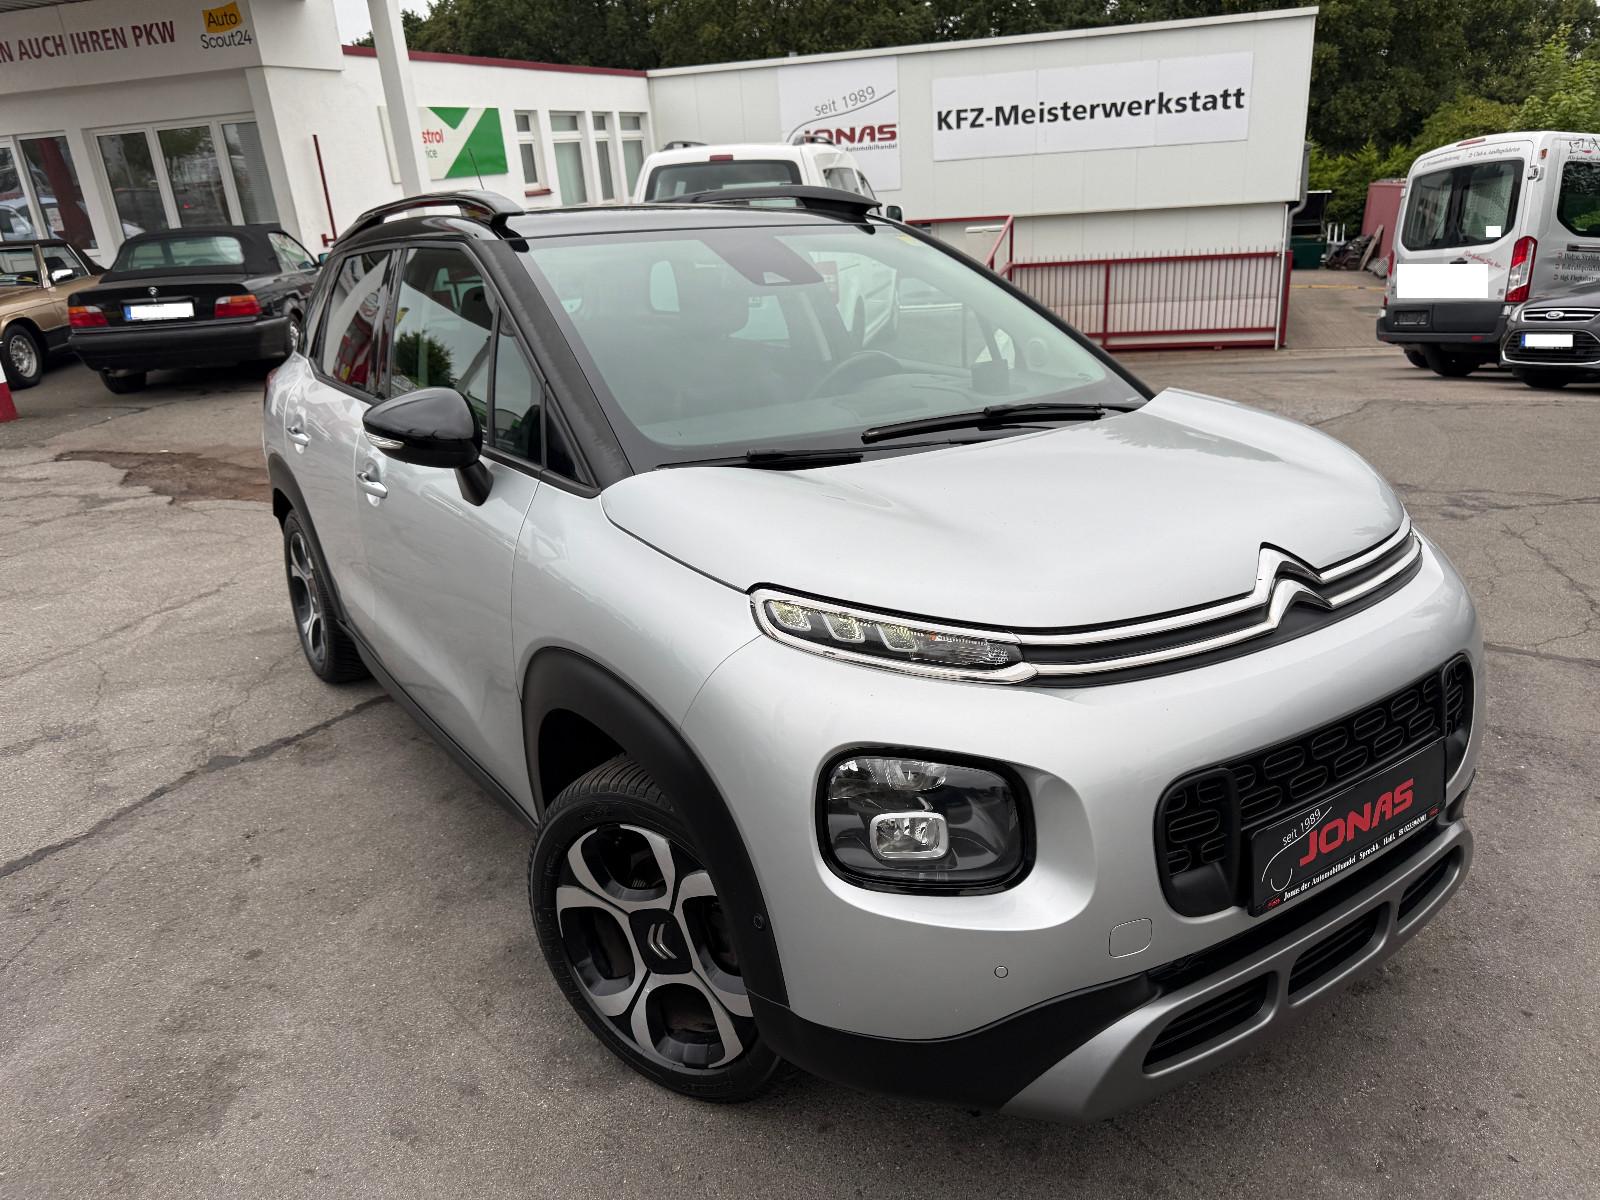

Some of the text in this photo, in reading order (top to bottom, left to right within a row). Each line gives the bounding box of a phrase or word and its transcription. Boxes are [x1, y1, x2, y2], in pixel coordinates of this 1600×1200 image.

[206, 11, 238, 28] Auto
[0, 20, 176, 63] N AUCH IHREN PKW
[201, 29, 252, 50] Scout24
[814, 86, 876, 117] seit 1989
[936, 86, 1246, 132] KFZ-Meisterwerkstatt
[422, 128, 444, 144] strol
[1282, 808, 1321, 846] seit 1989
[1299, 777, 1415, 868] JONAS
